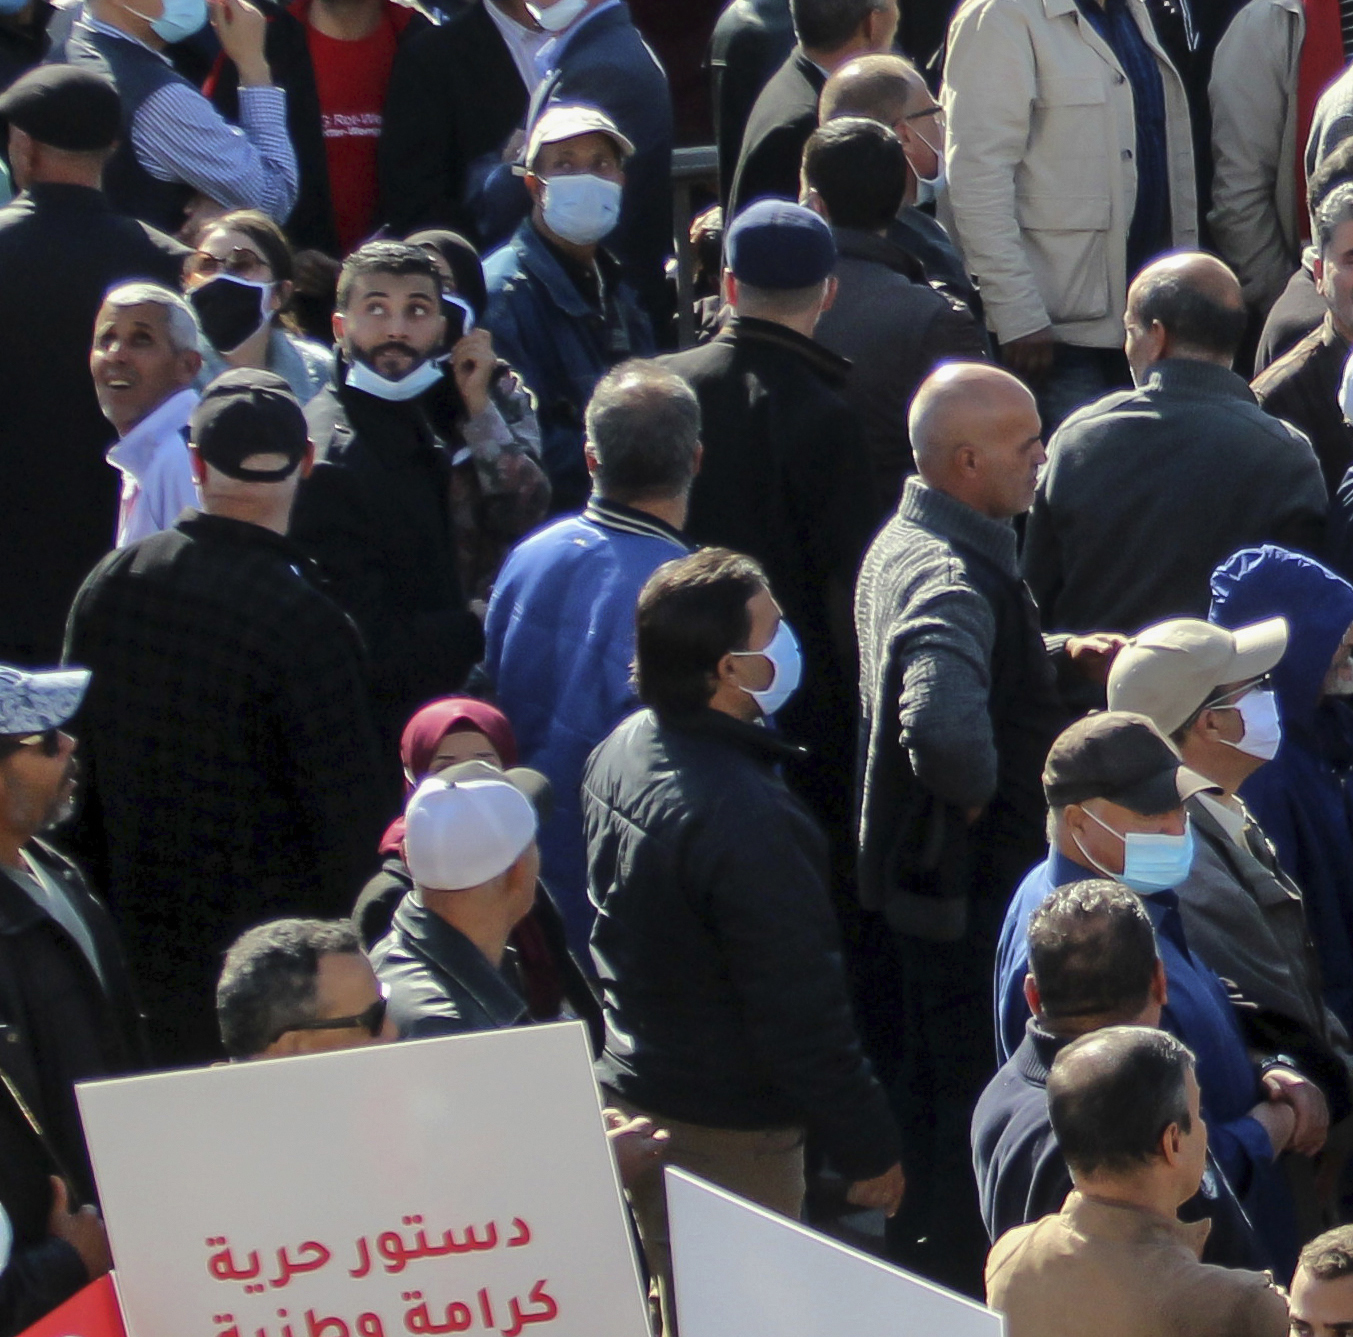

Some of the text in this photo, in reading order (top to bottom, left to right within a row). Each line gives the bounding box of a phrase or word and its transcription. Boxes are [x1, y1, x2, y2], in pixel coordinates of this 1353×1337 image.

[204, 1214, 532, 1293] دستور حرية
[401, 1278, 559, 1337] كرامة
